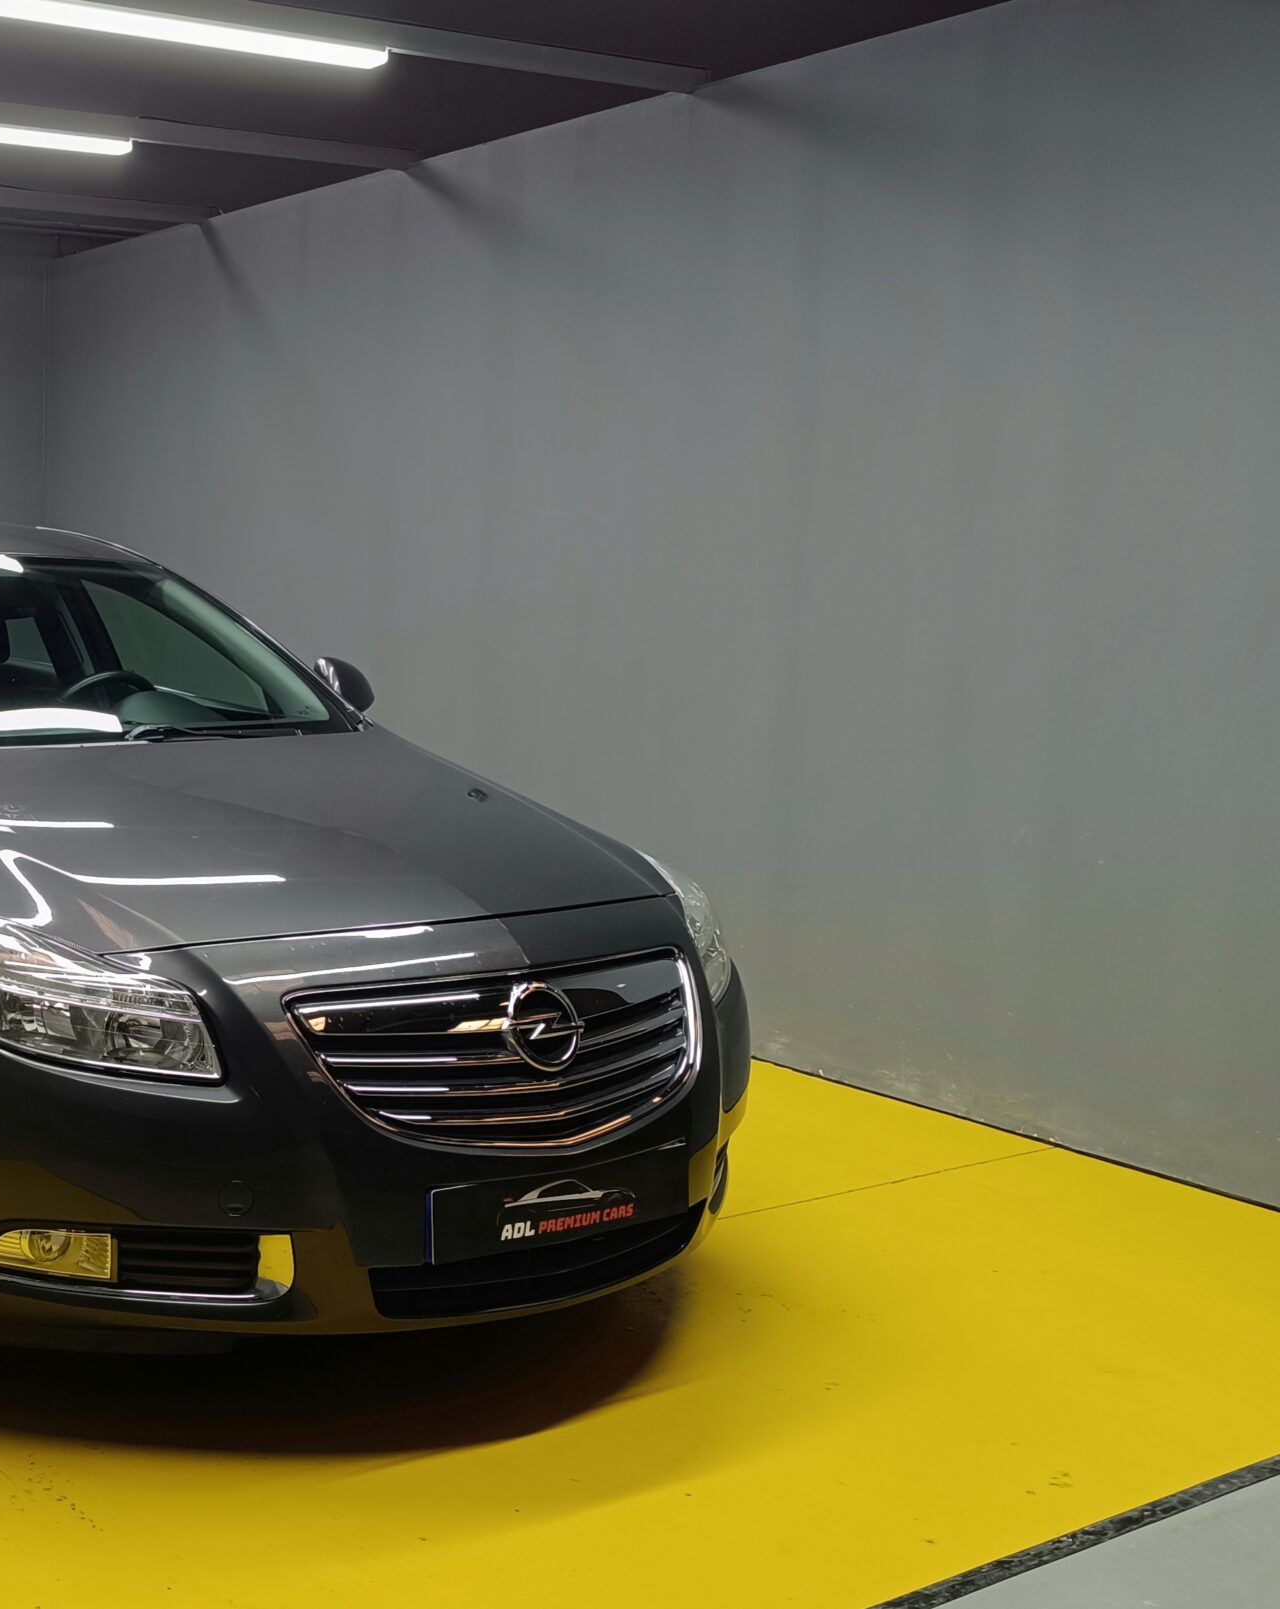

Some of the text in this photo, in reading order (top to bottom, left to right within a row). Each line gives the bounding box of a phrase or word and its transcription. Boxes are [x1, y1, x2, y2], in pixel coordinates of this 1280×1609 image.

[500, 1203, 635, 1241] ADL PREMIUM CARS
